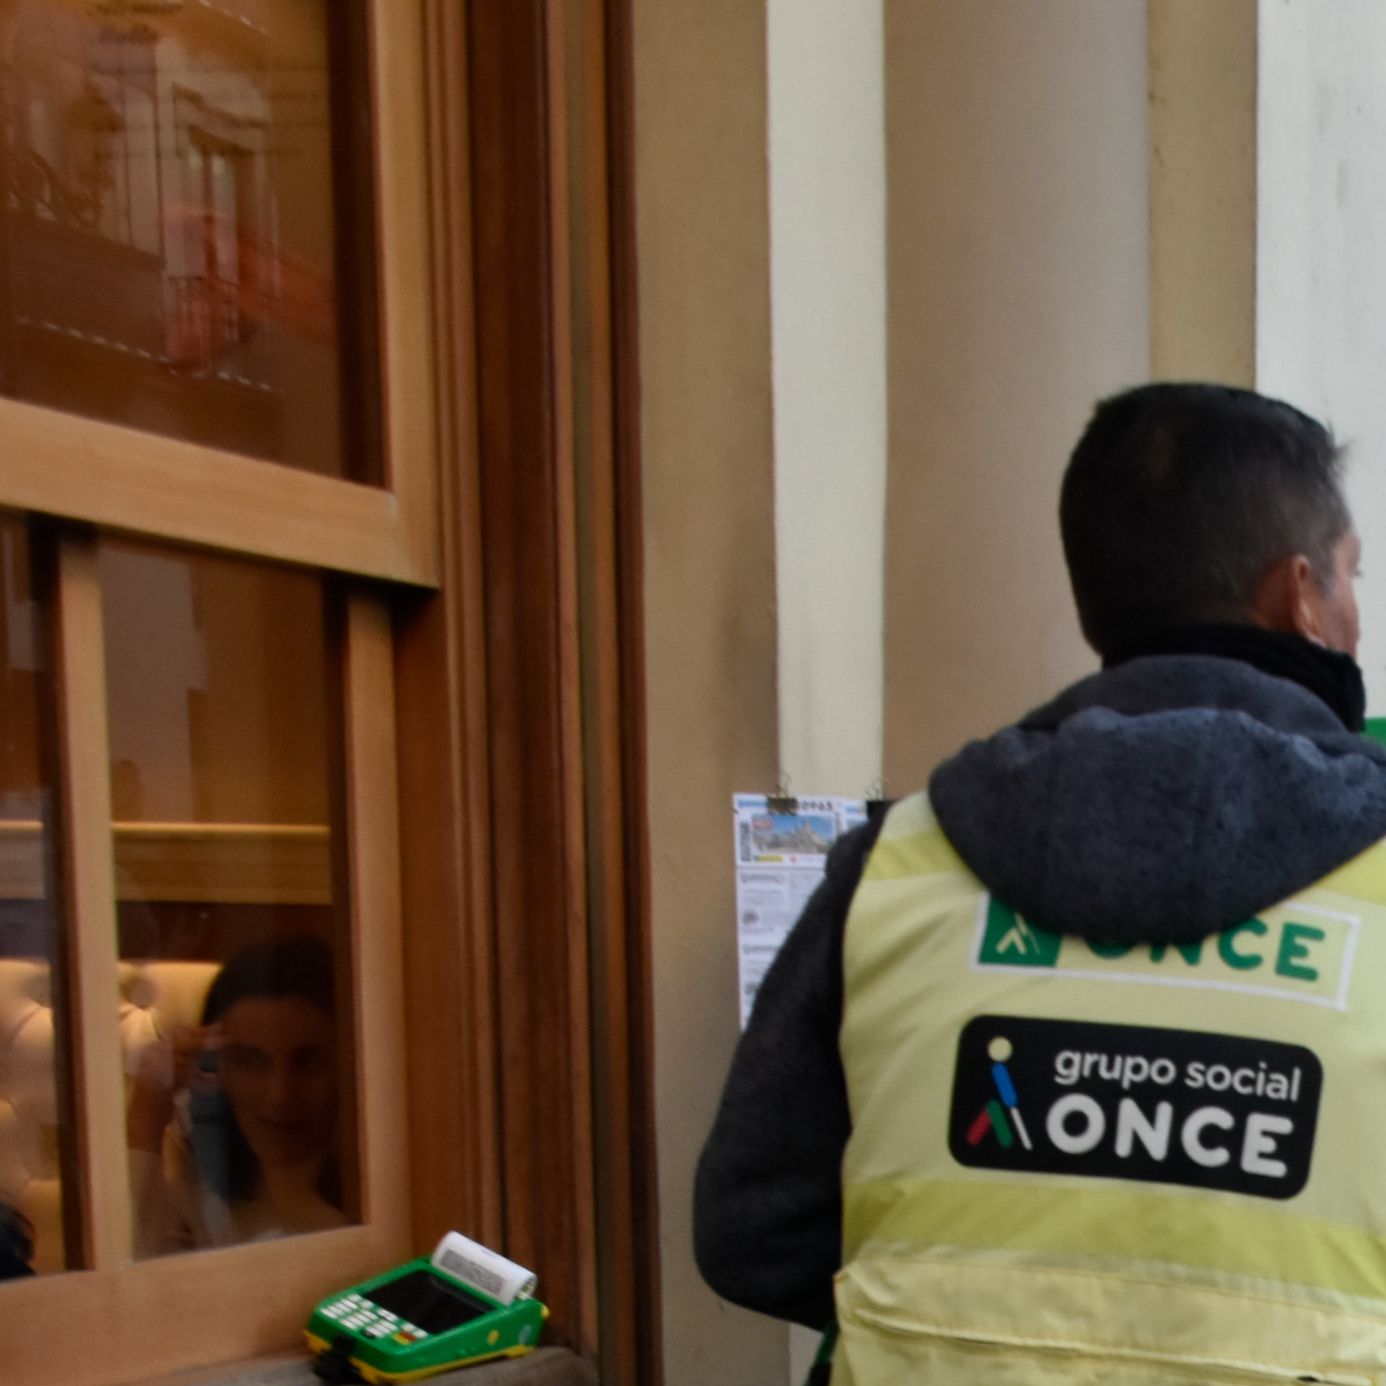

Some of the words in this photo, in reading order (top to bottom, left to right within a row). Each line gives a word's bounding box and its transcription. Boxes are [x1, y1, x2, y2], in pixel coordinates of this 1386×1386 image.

[1054, 1049, 1177, 1089] grupo
[1184, 1062, 1301, 1102] social
[1045, 1093, 1295, 1179] ONCE
